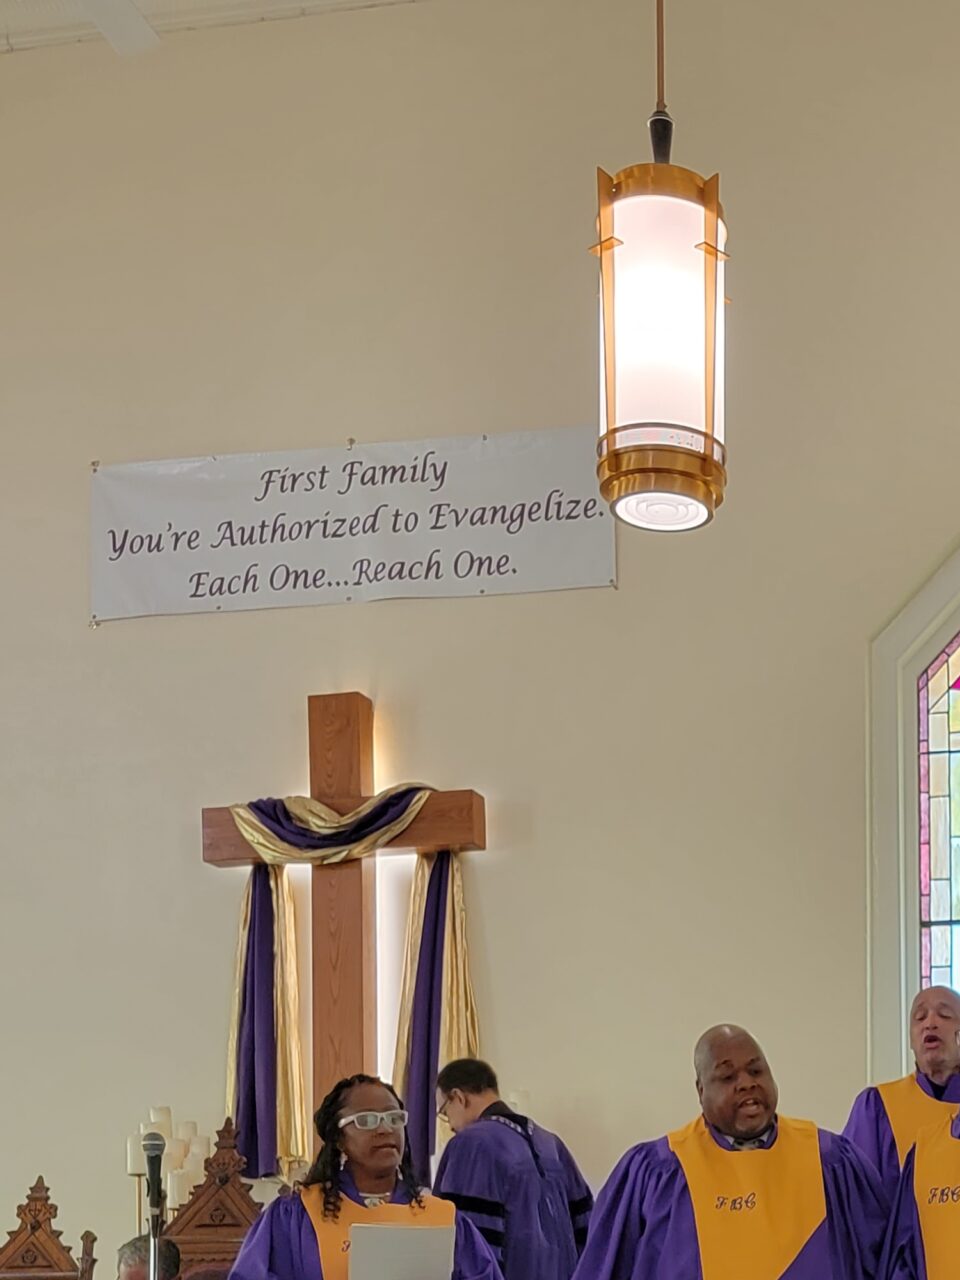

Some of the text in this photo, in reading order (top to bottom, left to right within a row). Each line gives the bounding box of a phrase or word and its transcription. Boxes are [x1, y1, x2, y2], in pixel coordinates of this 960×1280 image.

[254, 451, 448, 502] First Family
[107, 489, 605, 562] You're Authorized to Evangelize.
[188, 563, 260, 599] Each
[453, 550, 518, 579] One.
